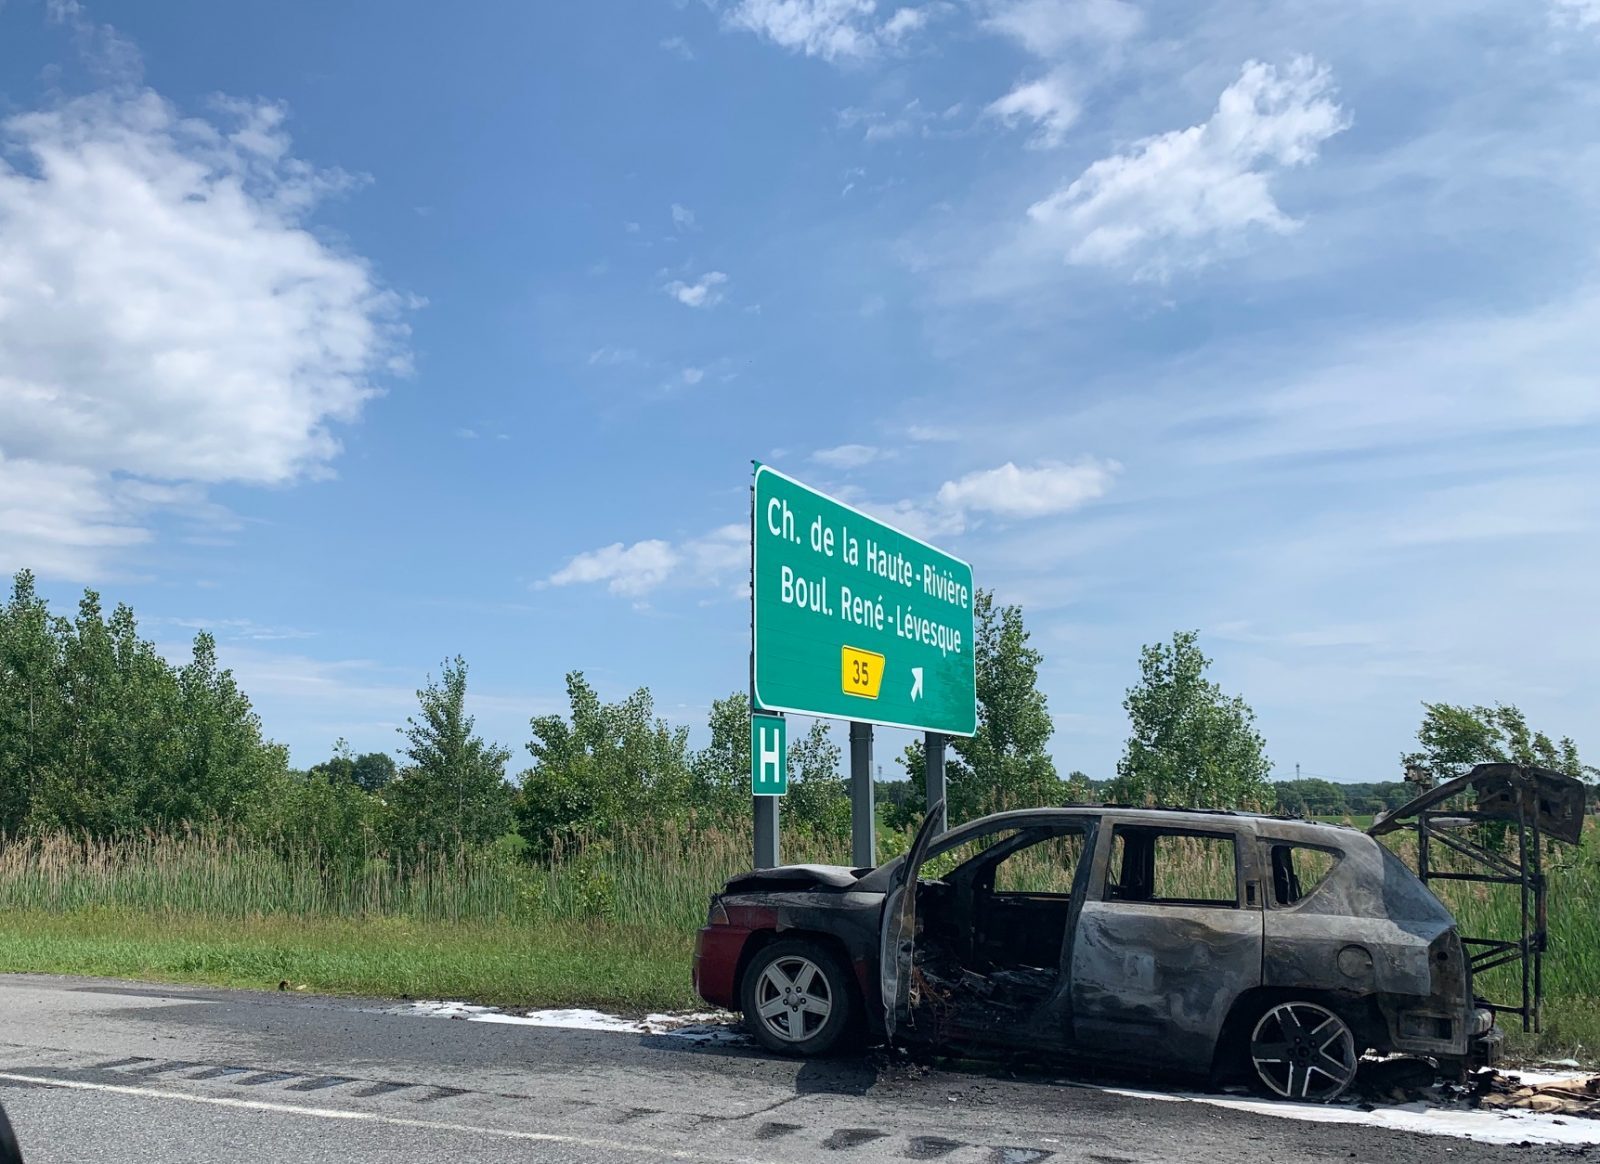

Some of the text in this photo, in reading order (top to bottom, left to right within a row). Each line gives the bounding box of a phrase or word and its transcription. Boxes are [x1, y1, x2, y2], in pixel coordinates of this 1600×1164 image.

[767, 497, 968, 608] Ch. de la Haute-Rivière
[781, 565, 961, 657] Boul. René-Lévesque
[852, 659, 869, 686] 35
[759, 727, 780, 783] H
